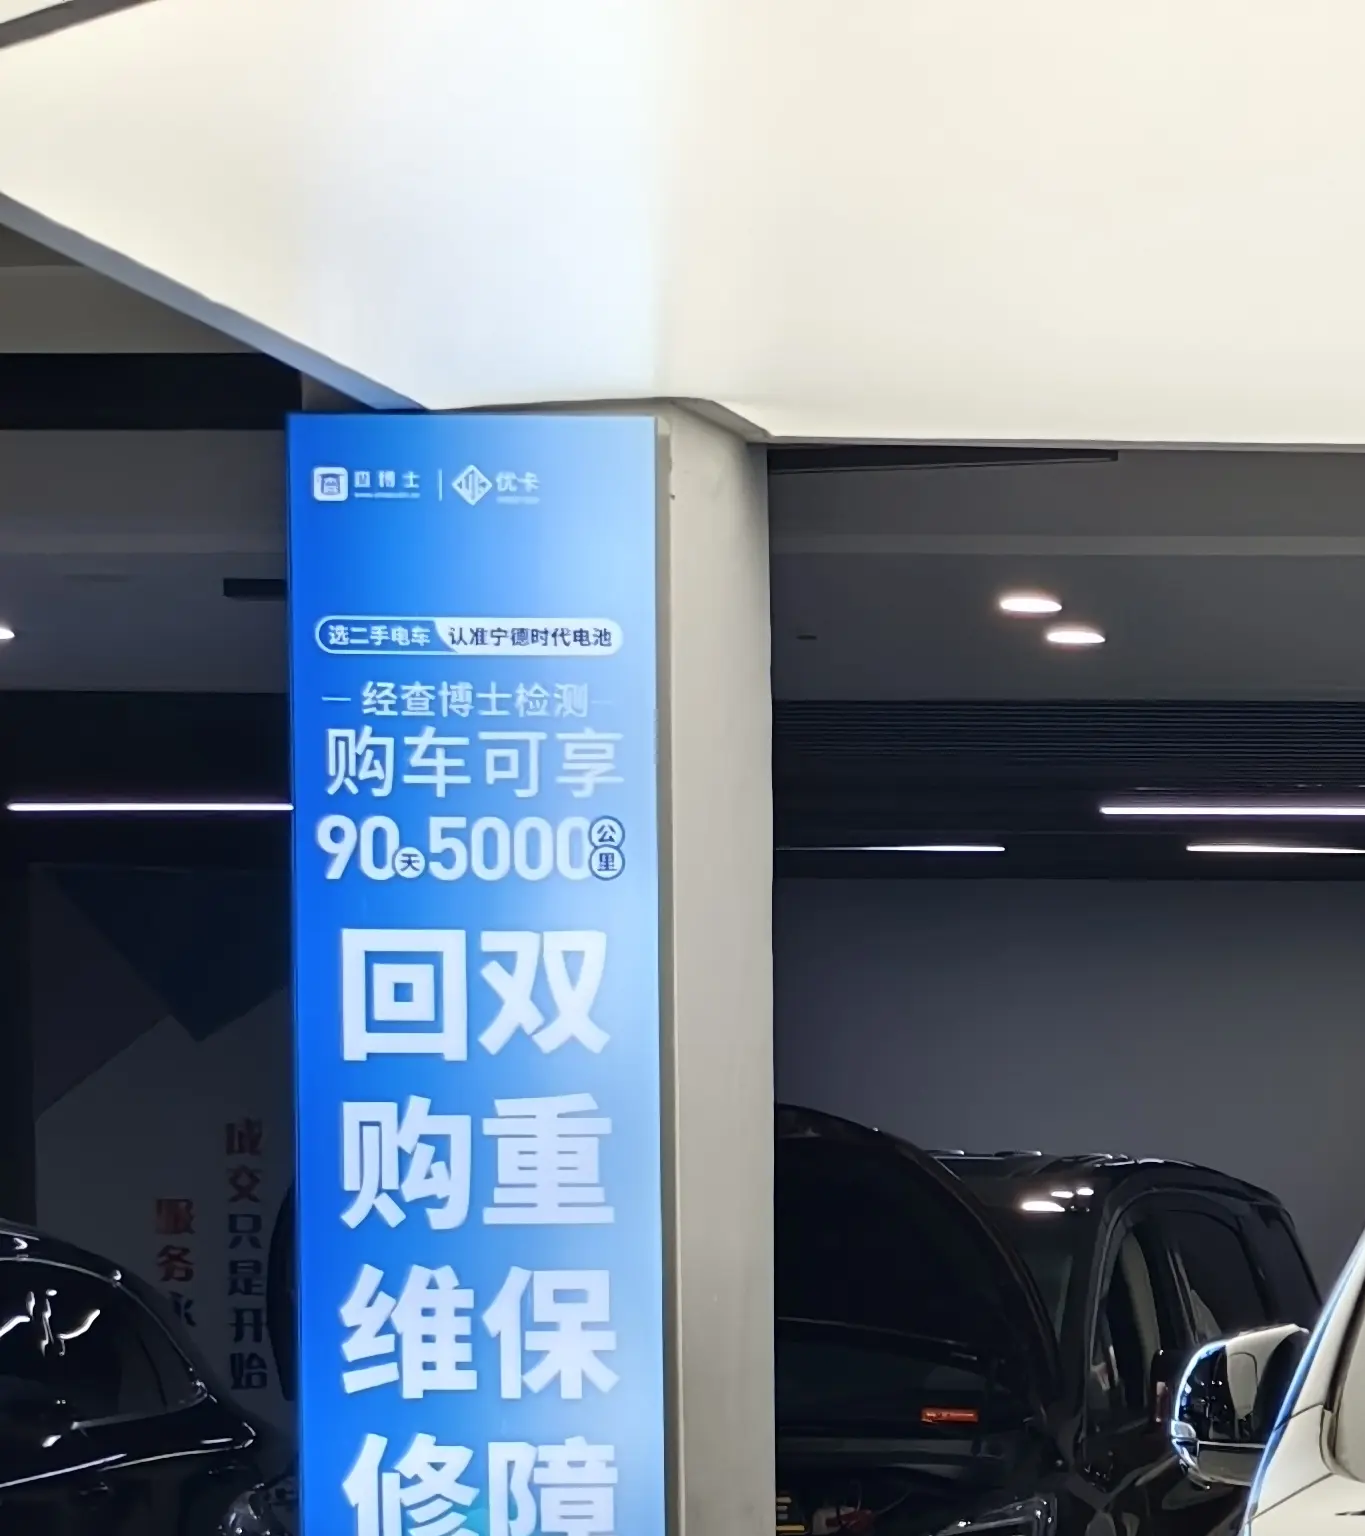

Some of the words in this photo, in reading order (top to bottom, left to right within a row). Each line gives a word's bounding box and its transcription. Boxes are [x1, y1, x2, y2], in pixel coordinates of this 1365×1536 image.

[328, 624, 431, 646] 选二手电车
[448, 627, 613, 647] 认准宁德时代电池
[361, 681, 589, 717] 经查博士检测
[326, 725, 625, 798] 购车可享
